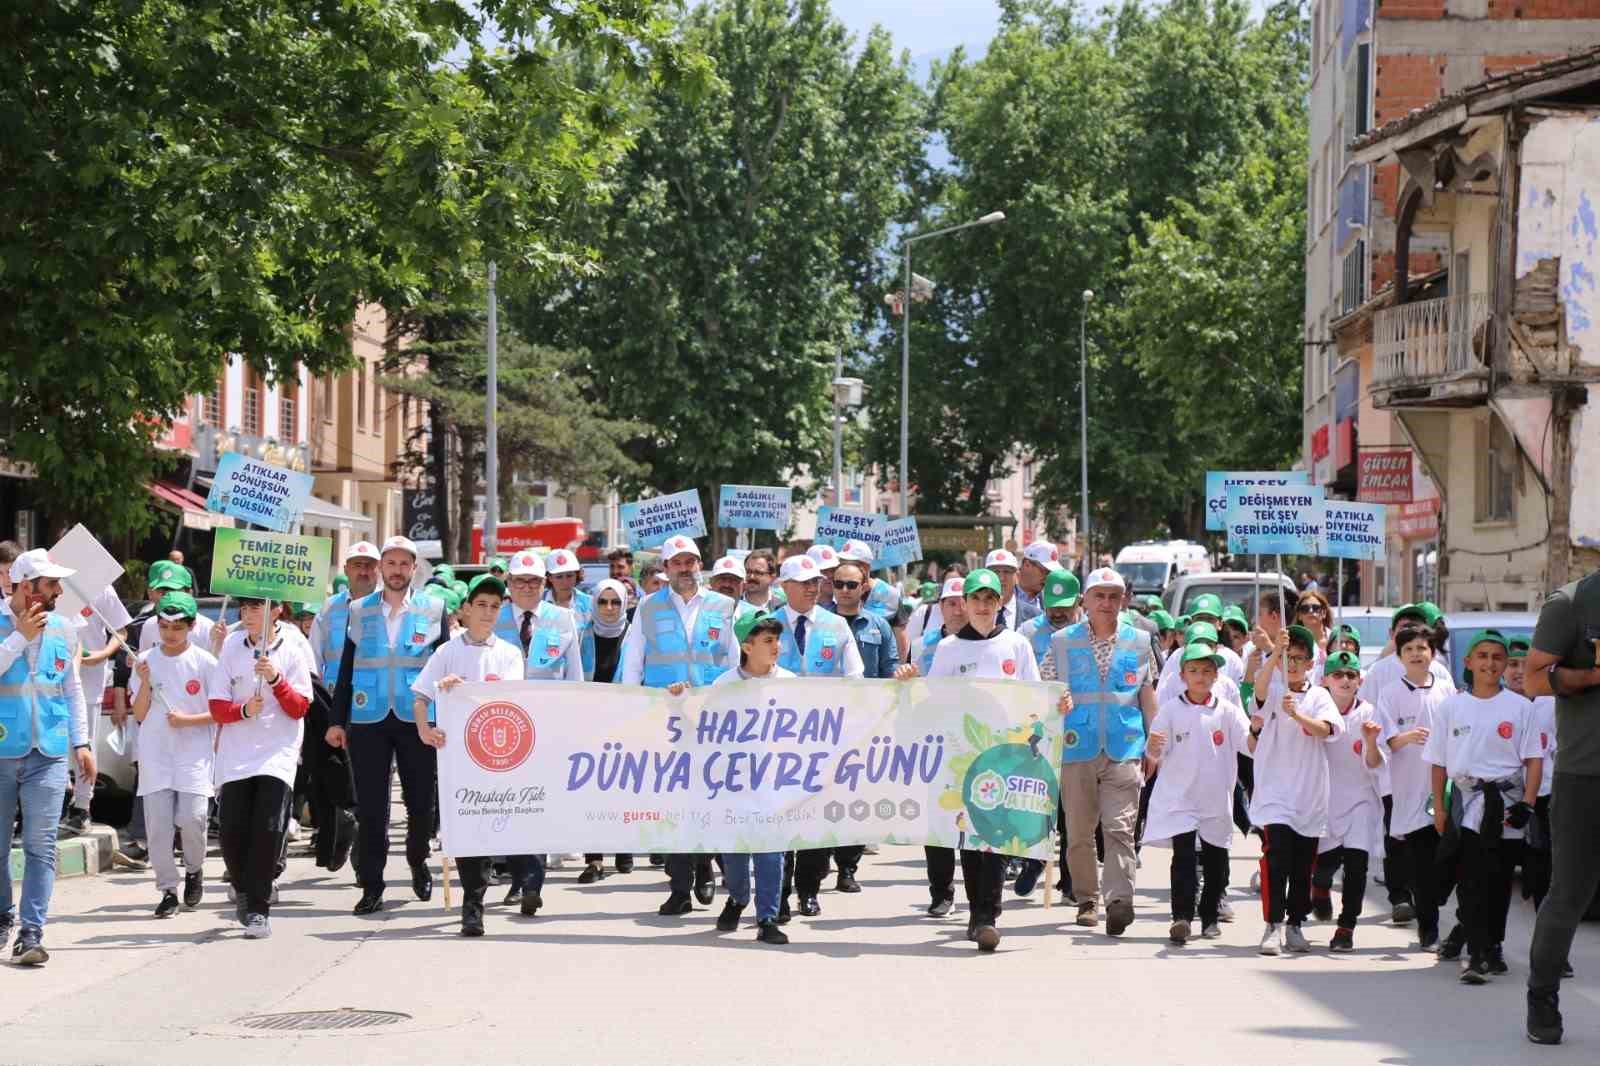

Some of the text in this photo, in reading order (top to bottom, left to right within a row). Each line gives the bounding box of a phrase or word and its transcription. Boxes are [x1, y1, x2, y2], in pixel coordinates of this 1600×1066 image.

[243, 463, 287, 482] ATIKLAR
[233, 485, 282, 507] DOĞAMIZ
[1209, 496, 1227, 512] ÇÖ
[1239, 493, 1312, 509] DEĞİŞMEYEN
[640, 500, 682, 516] SAĞLIKLI
[1254, 510, 1298, 523] TEK ŞEY
[1336, 510, 1374, 522] ATIKLA
[646, 512, 676, 527] ÇEVRE
[830, 513, 874, 528] HER ŞEY
[818, 526, 838, 538] ÇÖP
[240, 539, 308, 556] TEMİZ BİR
[232, 553, 311, 574] ÇEVRE İÇİN
[226, 567, 315, 587] YÜRÜYORUZ
[667, 698, 845, 745] 5 HAZİRAN
[566, 734, 944, 800] DÜNYA ÇEVRE GÜNÜ
[1008, 777, 1047, 796] SIFIR
[455, 786, 517, 806] Mustafa
